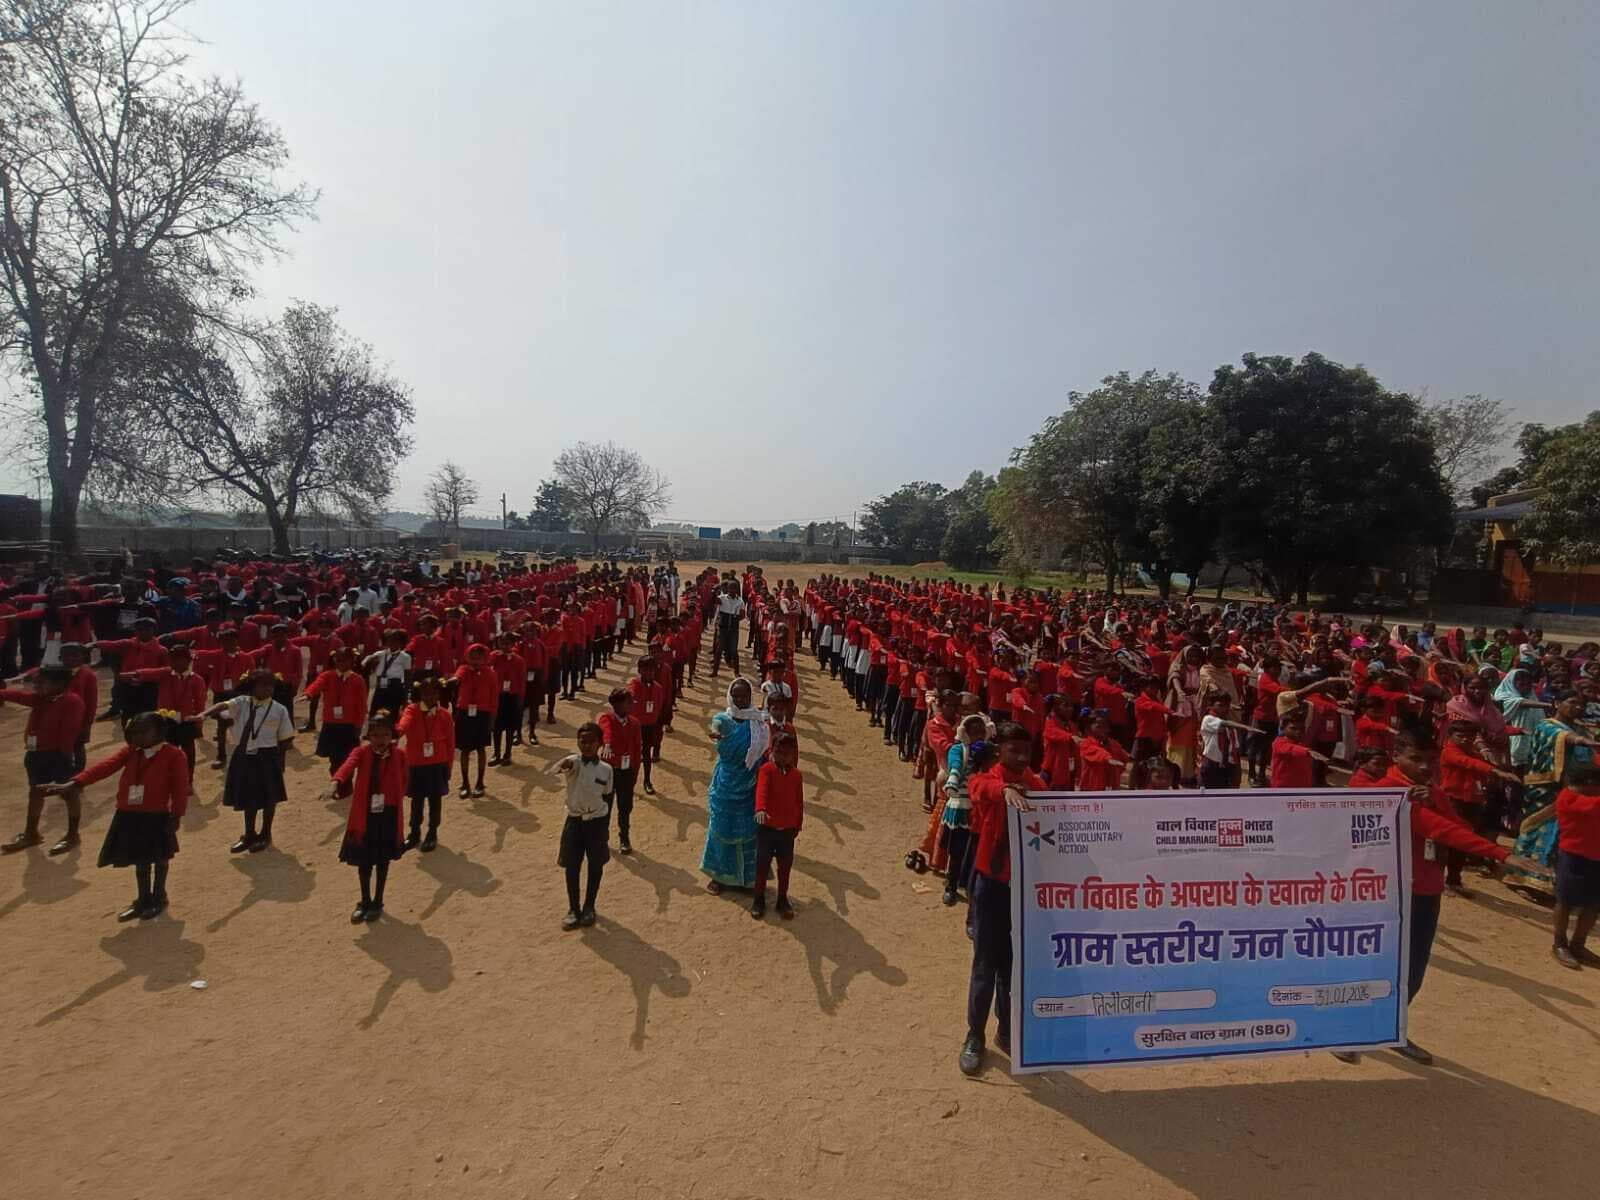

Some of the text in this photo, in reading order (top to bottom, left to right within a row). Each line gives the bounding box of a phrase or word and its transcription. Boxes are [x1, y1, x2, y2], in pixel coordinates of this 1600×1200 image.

[1058, 820, 1111, 831] ASSOCIATION
[1155, 820, 1182, 833] बाल
[1184, 817, 1217, 833] विवाह
[1244, 819, 1274, 833] भारत
[1351, 814, 1383, 829] JUST
[1058, 831, 1124, 843] FOR VOLUNTARY
[1155, 834, 1275, 846] CHILD MARRIAGE FREE INDIA
[1058, 844, 1089, 855] ACTION
[1035, 868, 1388, 911] बाल विवाह के अपराध के खात्मे के लिए
[1051, 917, 1385, 968] ग्राम स्तरीय जन चौपाल
[1271, 989, 1303, 1003] दिनांक
[1037, 1002, 1065, 1014] स्थान
[1141, 1023, 1291, 1048] सुरक्षित बाल ग्राम (SBG)
